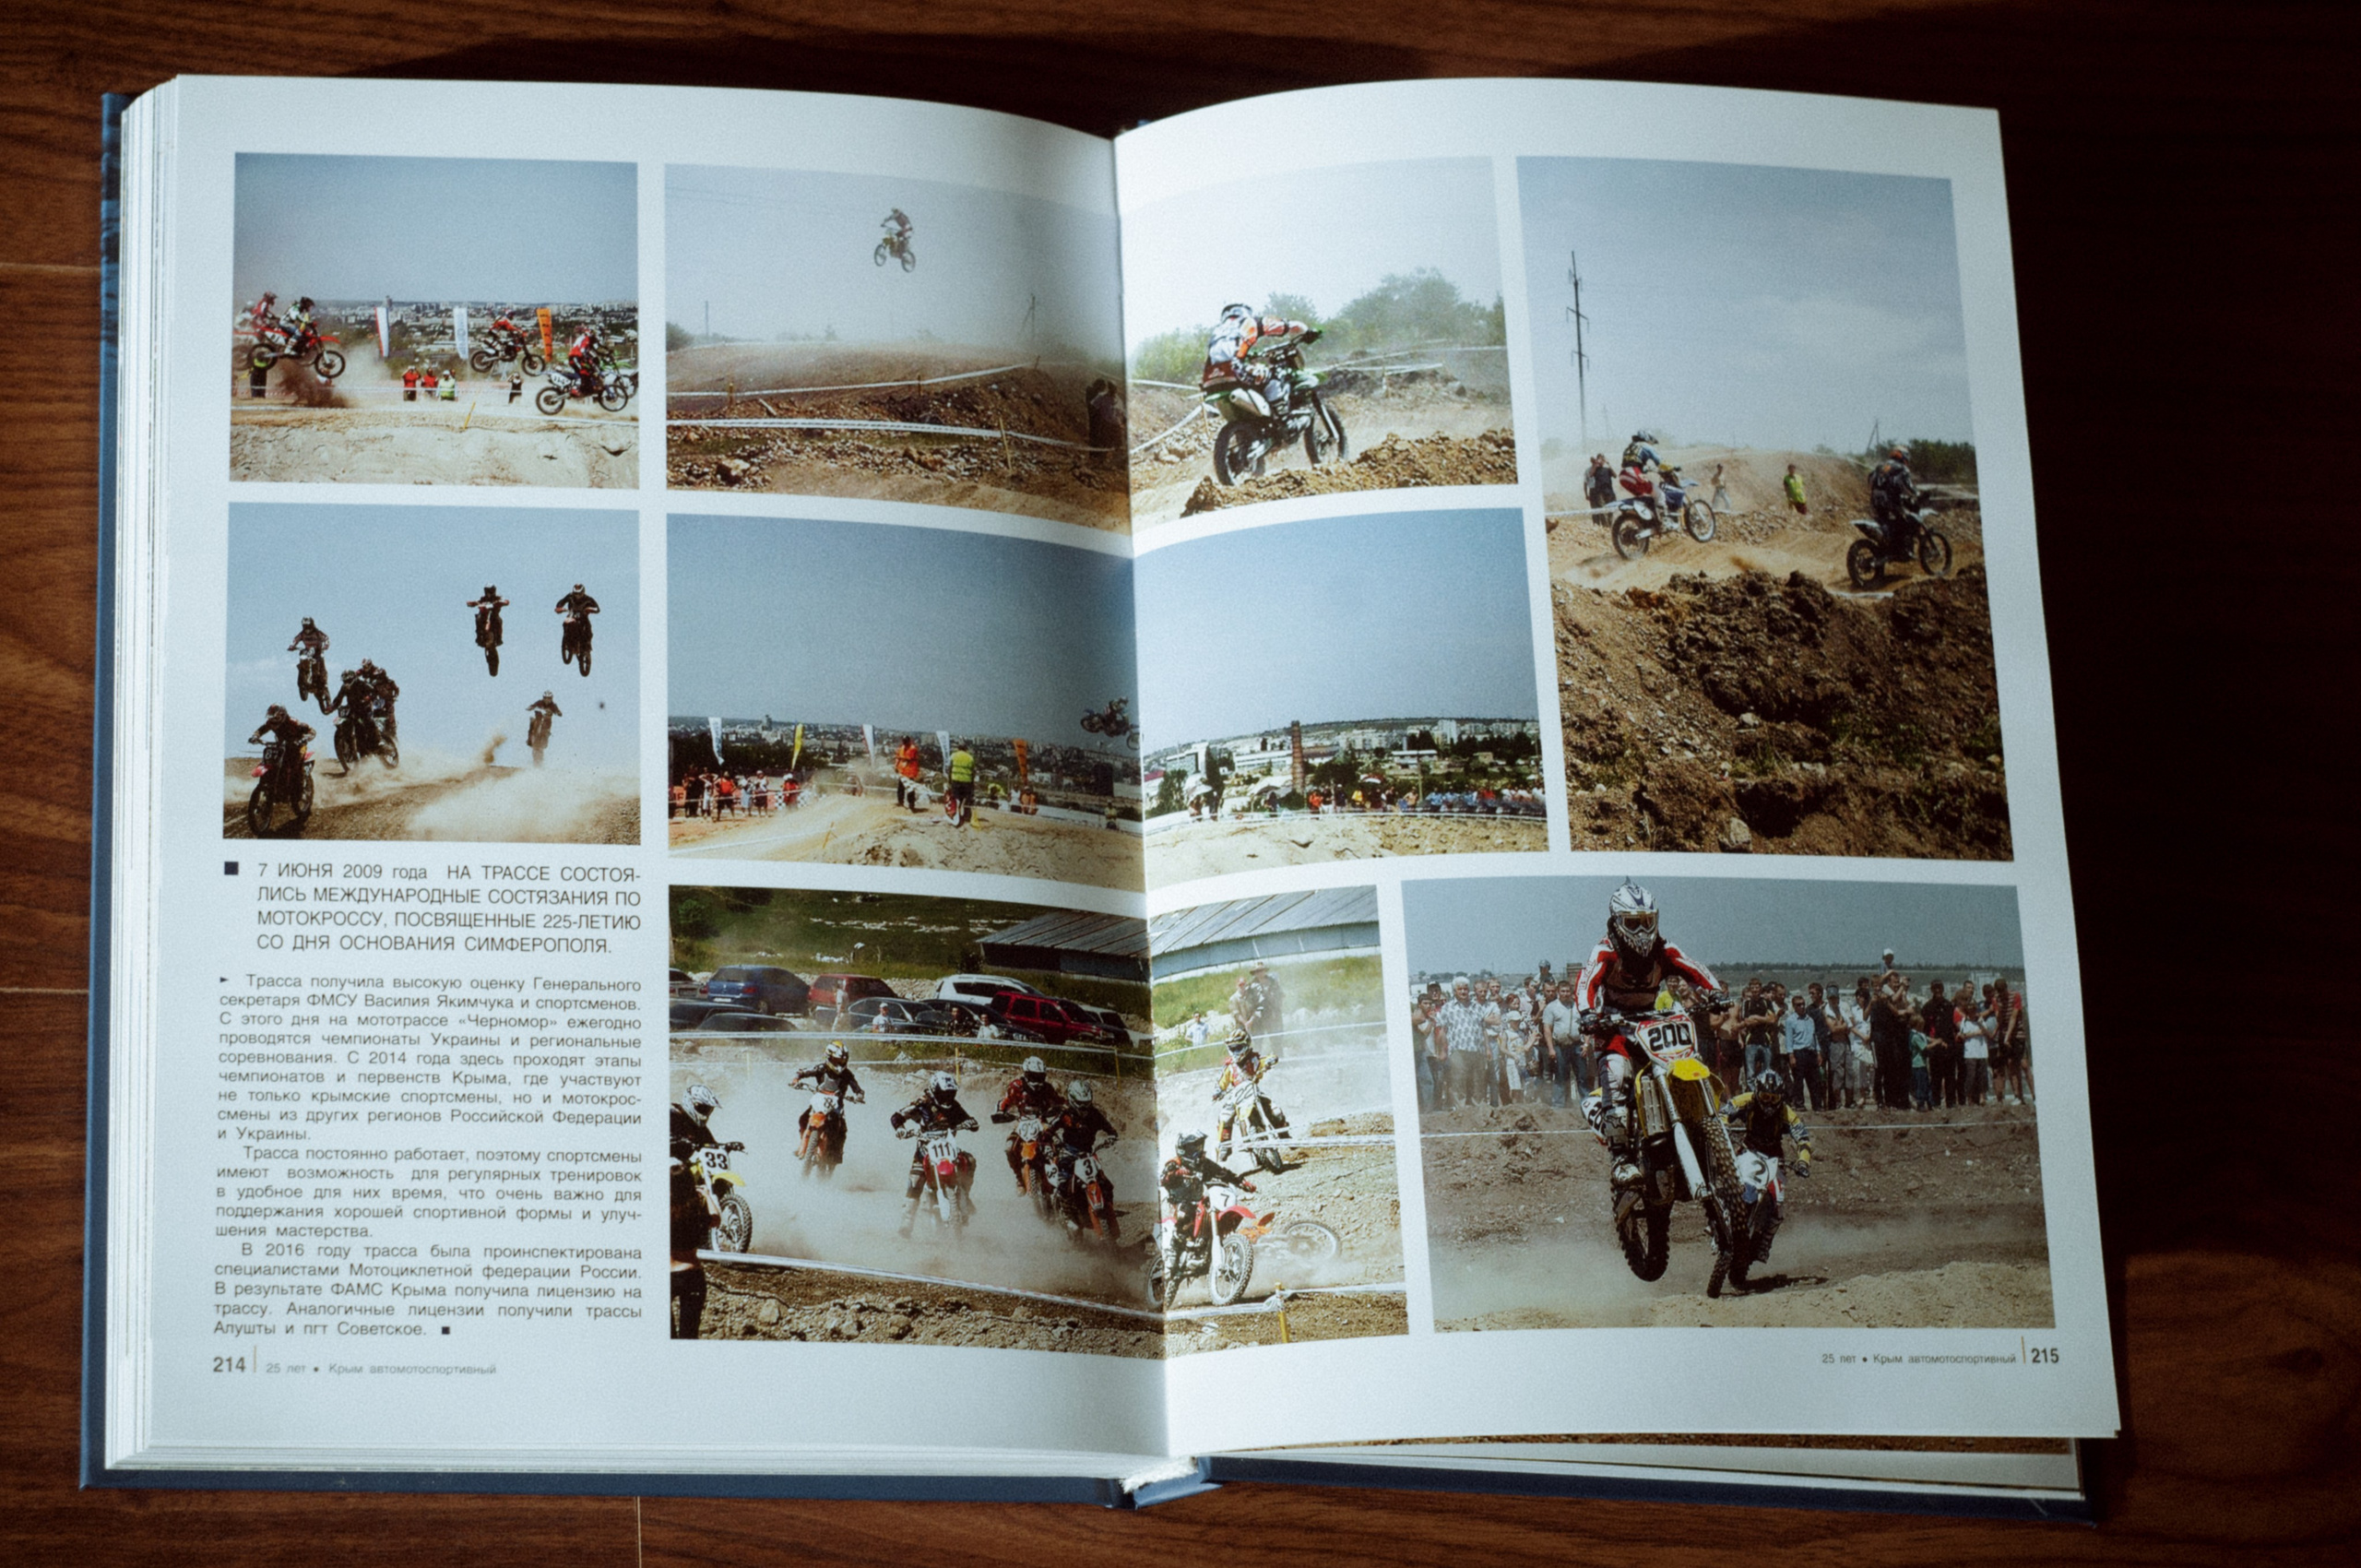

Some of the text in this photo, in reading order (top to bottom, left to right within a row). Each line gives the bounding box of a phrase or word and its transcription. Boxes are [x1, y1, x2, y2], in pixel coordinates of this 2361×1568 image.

[257, 861, 642, 883] 7 ИЮНЯ 2009 года НА ТРАССЕ СОСТОЯ-
[256, 885, 642, 908] ЛИСЬ МЕЖДУНАРОДНЫЕ СОСТЯЗАНИЯ ПО
[256, 909, 642, 932] МОТОКРОССУ, ПОСВЯЩЕННЫЕ 225-ЛЕТИЮ
[255, 933, 612, 954] СО ДНЯ ОСНОВАНИЯ СИМФЕРОПОЛЯ.
[245, 973, 642, 993] Трасса получила высокую оценку Генерального
[219, 992, 641, 1012] секретаря ФМСУ Василия Якимчука и спортсменов.
[219, 1011, 642, 1031] С этого дня на мототрассе «Черномор» ежегодно
[219, 1032, 642, 1050] проводятся чемпионаты Украины и региональные
[1647, 1023, 1693, 1052] 200
[218, 1050, 642, 1069] соревнования. С 2014 года здесь проходят этапы
[219, 1070, 642, 1089] чемпионатов и первенств Крыма, где участвуют
[218, 1090, 643, 1108] не только крымские спортсмены, но и мотокрос-
[217, 1108, 642, 1127] смены из других регионов Российской Федерации
[217, 1126, 311, 1143] и Украины.
[243, 1145, 643, 1165] Трасса постоянно работает, поэтому спортсмены
[705, 1151, 729, 1170] 33
[216, 1168, 643, 1184] имеют возможность для регулярных тренировок
[1750, 1159, 1767, 1184] 2
[216, 1184, 643, 1204] в удобное для них время, что очень важно для
[1220, 1193, 1230, 1207] 7
[215, 1206, 642, 1224] поддержания хорошей спортивной формы и улуч-
[215, 1225, 373, 1240] шения мастерства.
[241, 1241, 643, 1262] В 2016 году трасса была проинспектирована
[214, 1263, 642, 1280] специалистами Мотоциклетной федерации России.
[214, 1280, 643, 1301] В результате ФАМС Крыма получила лицензию на
[213, 1301, 643, 1321] трассу. Аналогичные лицензии получили трассы
[213, 1320, 427, 1337] Алушты и пгт Советское.
[213, 1356, 245, 1372] 214
[1821, 1353, 2016, 1366] 25 лет Крым автомотоспортивный
[2031, 1348, 2059, 1364] 215
[266, 1362, 497, 1375] 25 лет Крым автомотоспортивный
